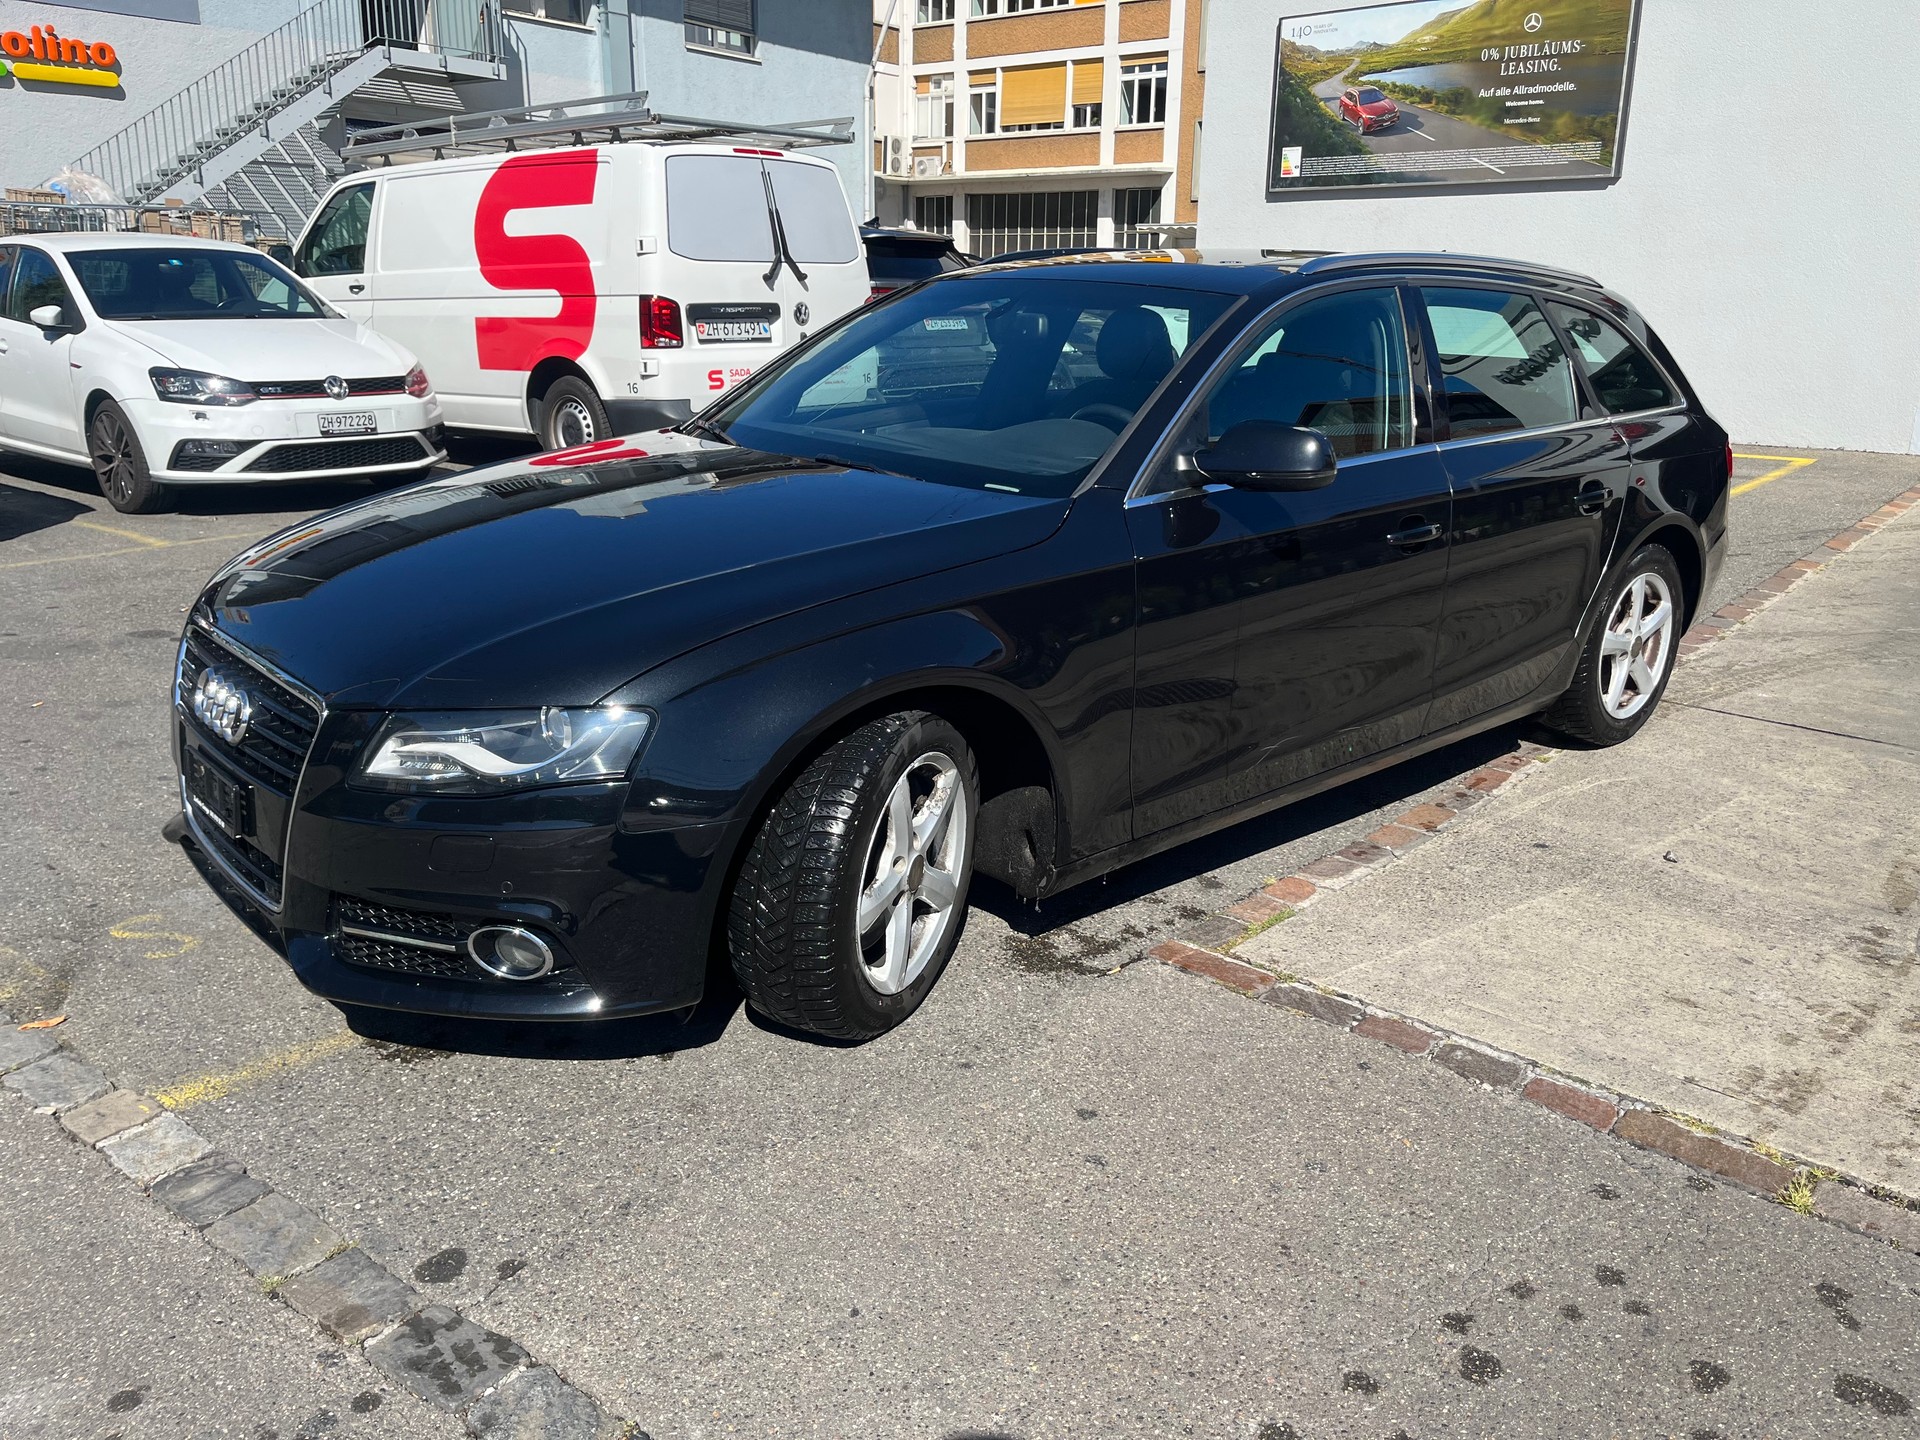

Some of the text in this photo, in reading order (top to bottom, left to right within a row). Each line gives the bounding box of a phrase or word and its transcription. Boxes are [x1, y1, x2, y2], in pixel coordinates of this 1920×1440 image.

[1291, 25, 1312, 39] 140
[1, 24, 116, 67] olino
[1481, 39, 1587, 61] 0% JUBILÄUMS-
[1499, 58, 1562, 76] LEASING.
[1478, 81, 1577, 98] Auf alle Allradmodelle.
[1503, 116, 1541, 125] Mercedes-Benz
[707, 368, 751, 391] S SADA
[862, 373, 872, 384] 16
[259, 386, 283, 394] GTI
[627, 382, 639, 394] 16
